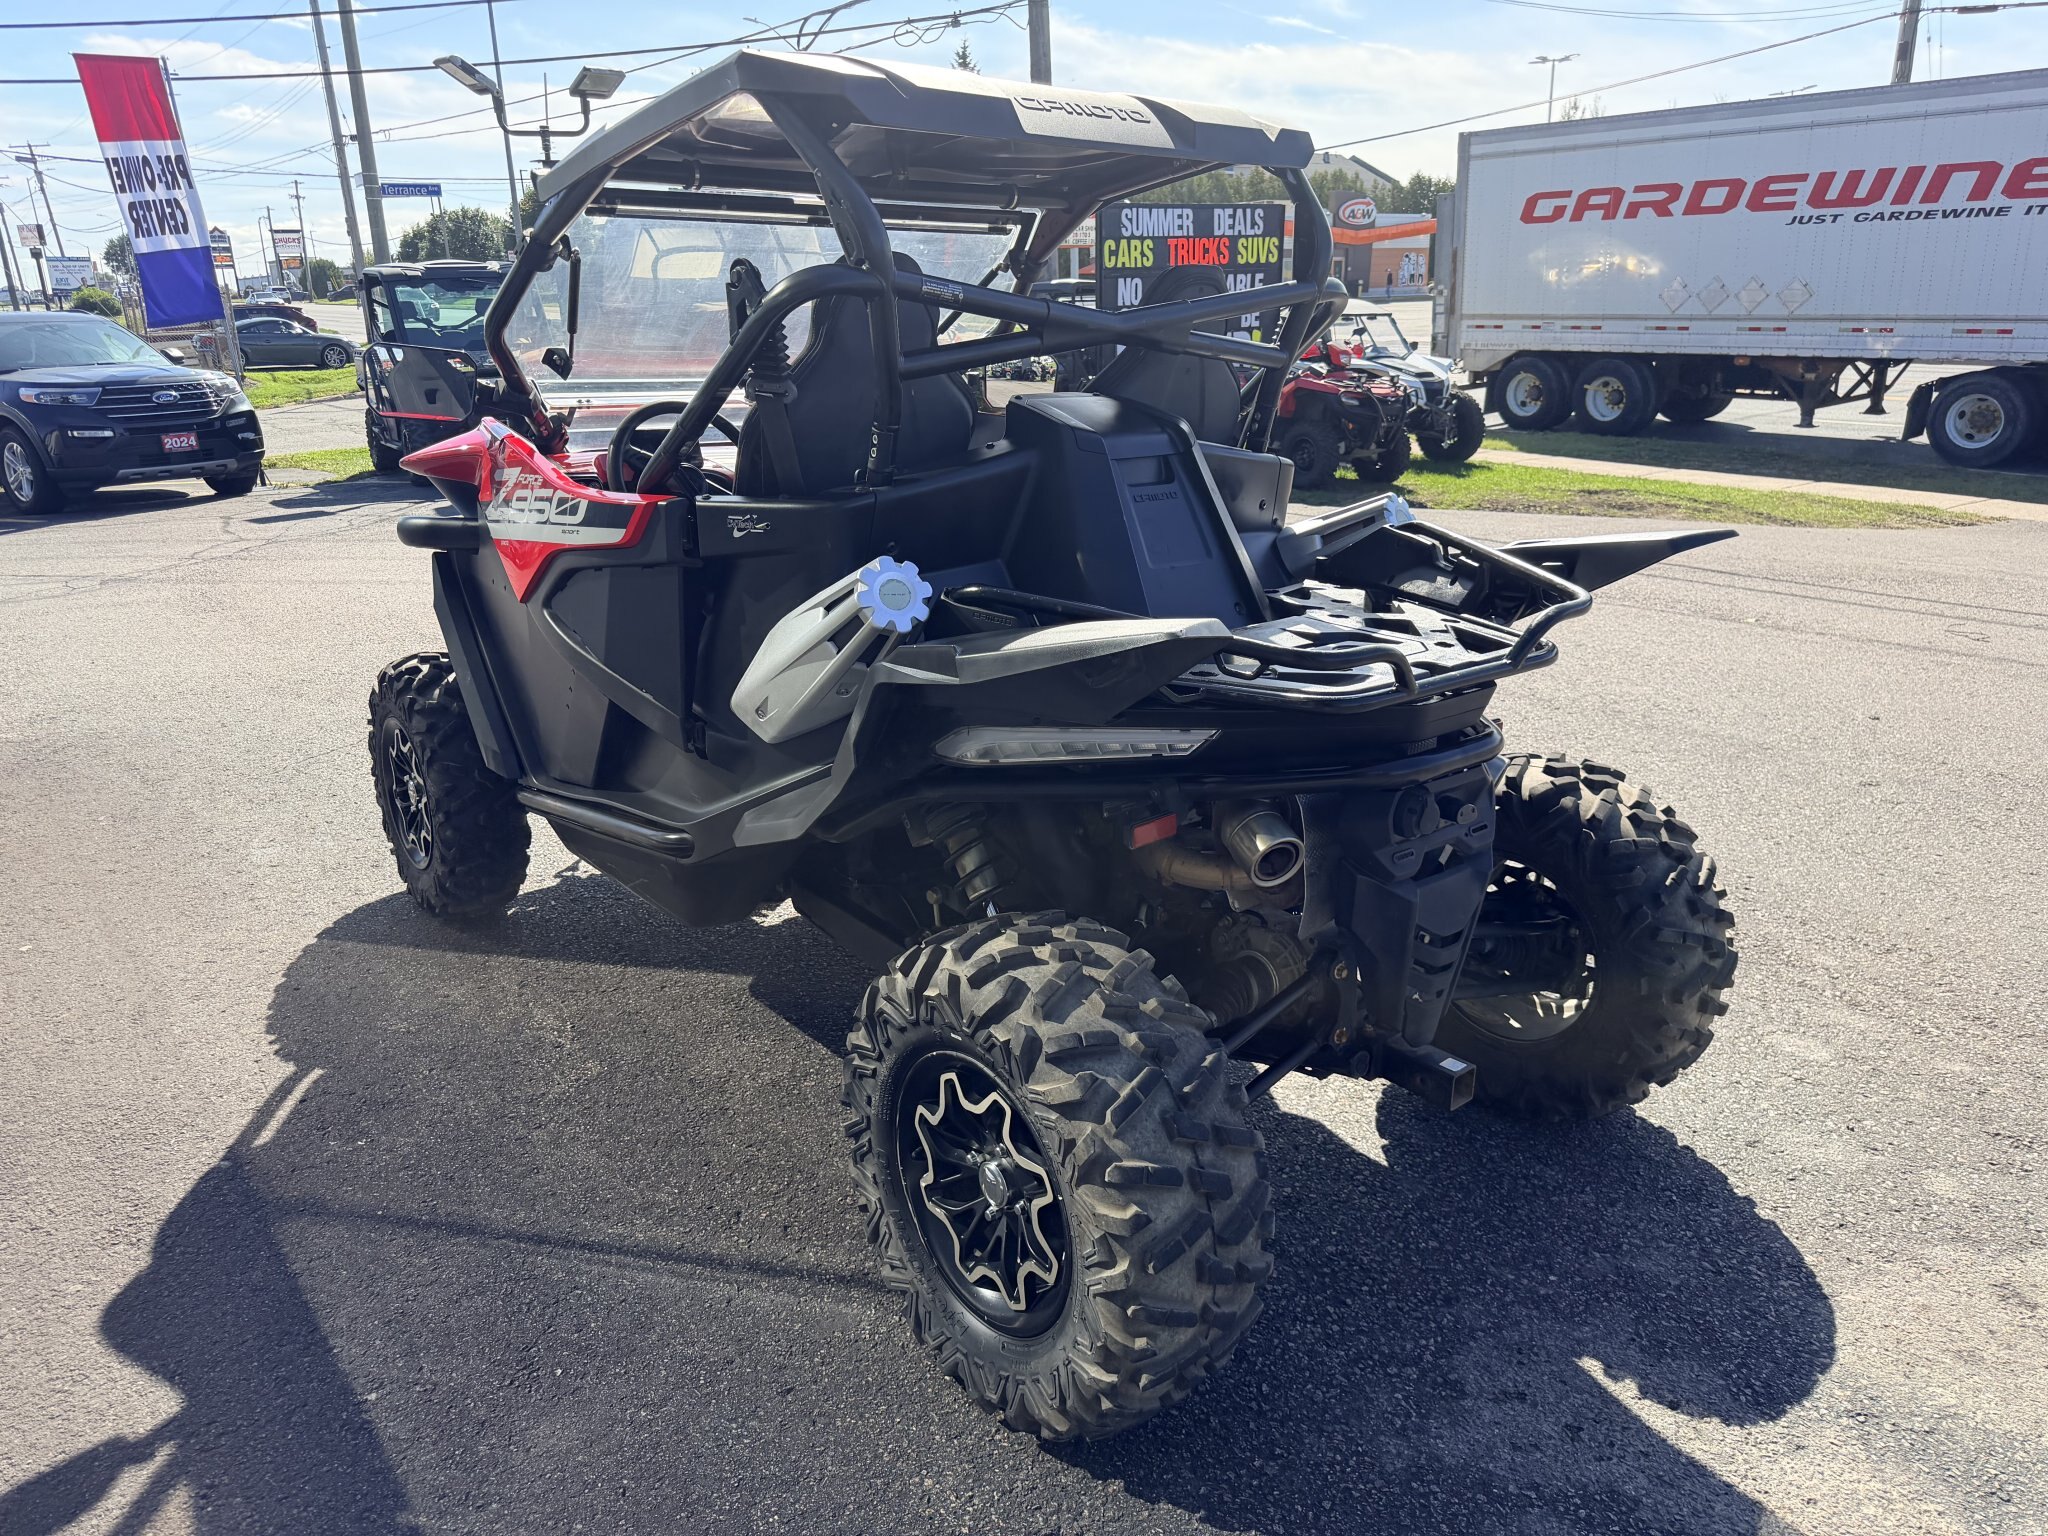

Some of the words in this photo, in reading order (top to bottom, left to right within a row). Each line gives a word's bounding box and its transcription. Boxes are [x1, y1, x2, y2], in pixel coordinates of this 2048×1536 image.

[383, 185, 428, 195] Terrance
[1520, 157, 2048, 224] GARDEWINE
[1121, 207, 1194, 237] SUMMER
[1213, 207, 1264, 236] DEALS
[1347, 208, 1374, 219] A&W
[1785, 213, 1845, 225] JUST
[1853, 206, 2012, 222] GARDEWINE
[2023, 204, 2048, 215] IT
[1103, 238, 1154, 268] CARS
[1168, 237, 1230, 267] TRUCKS
[1237, 236, 1279, 265] SUVS
[1117, 277, 1143, 306] NO
[164, 436, 197, 449] 2024
